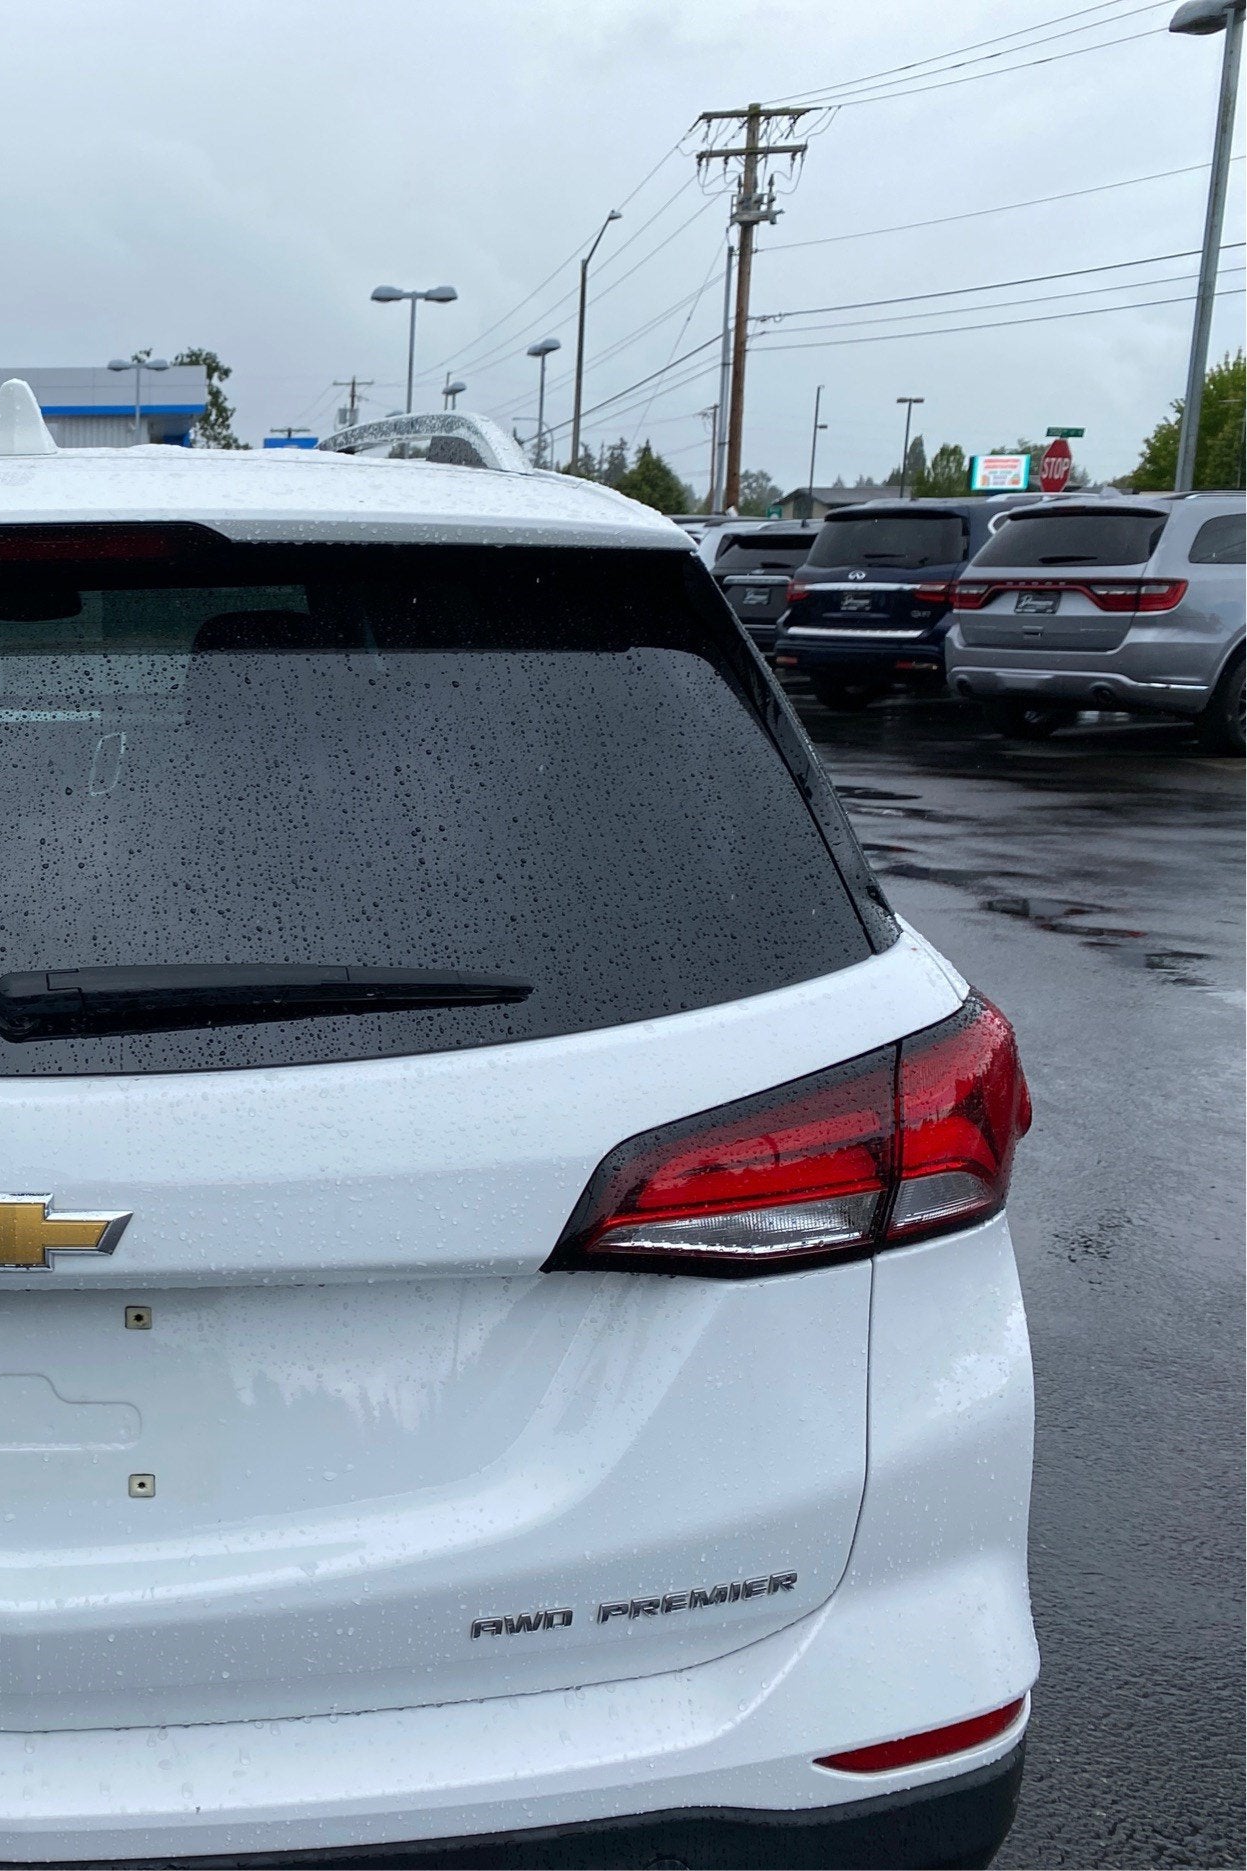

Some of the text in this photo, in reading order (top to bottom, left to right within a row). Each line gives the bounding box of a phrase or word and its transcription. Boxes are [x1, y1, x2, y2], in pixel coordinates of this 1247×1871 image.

[1042, 457, 1070, 479] STOP
[471, 1569, 798, 1640] AWD PREMIER
